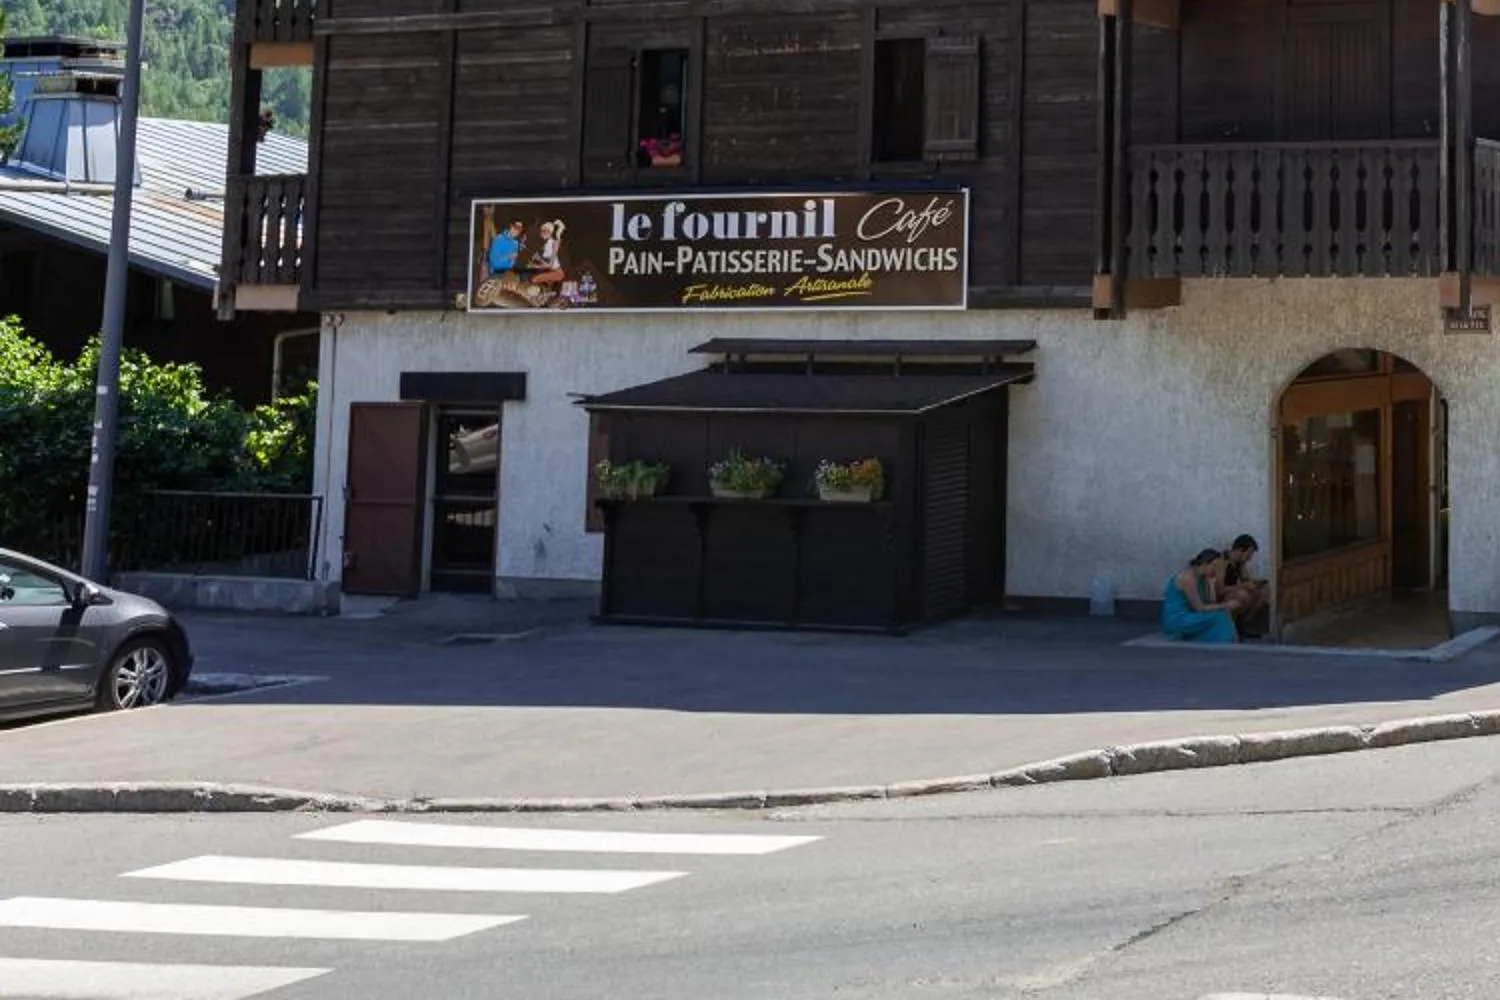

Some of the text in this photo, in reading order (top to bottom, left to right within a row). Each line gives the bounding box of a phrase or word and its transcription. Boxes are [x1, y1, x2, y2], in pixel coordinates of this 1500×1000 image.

[609, 199, 836, 242] le fournil
[856, 197, 954, 243] Café
[681, 283, 775, 304] Fabrication
